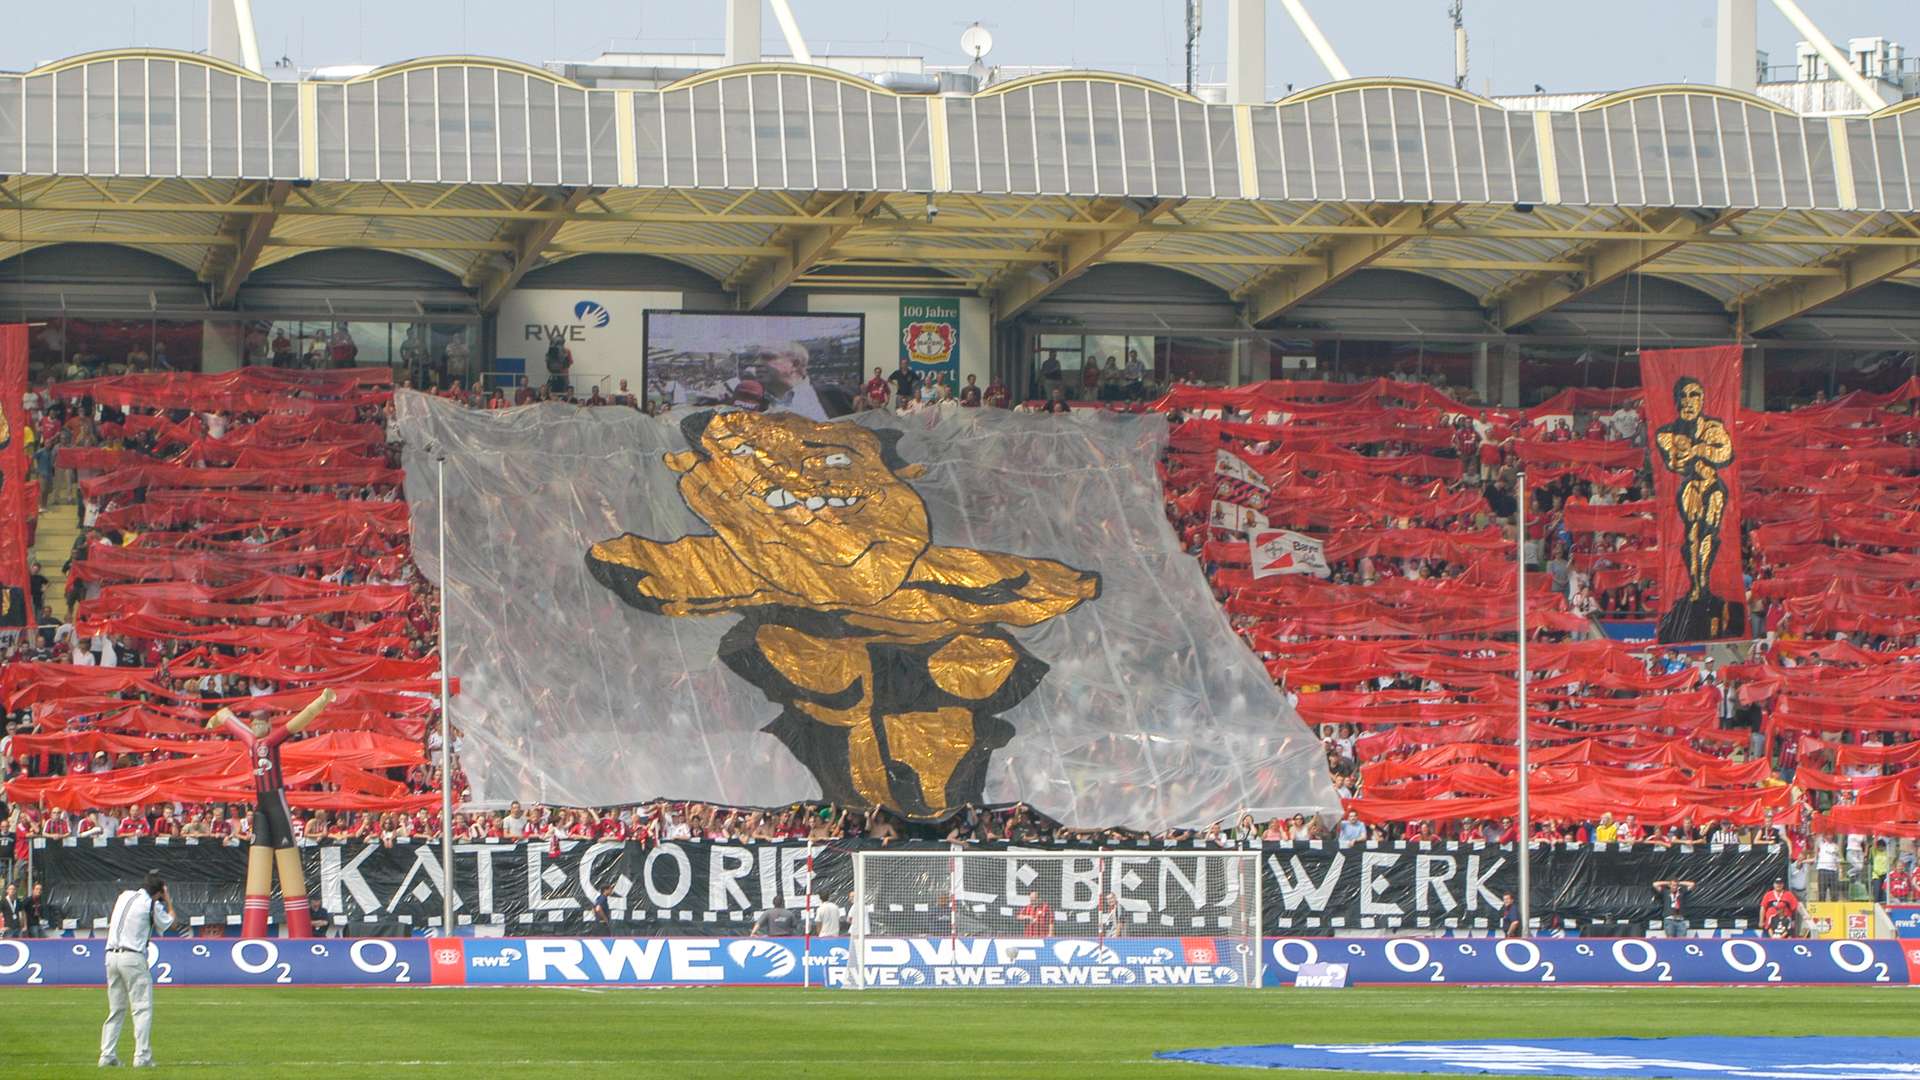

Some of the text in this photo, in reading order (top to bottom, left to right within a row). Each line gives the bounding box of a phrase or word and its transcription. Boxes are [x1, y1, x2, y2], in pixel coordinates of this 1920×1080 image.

[903, 306, 957, 318] 100 Jahre
[524, 324, 586, 341] RWE
[320, 841, 828, 914] KATEGORIE
[0, 940, 43, 983] O2
[231, 939, 293, 983] O2
[350, 939, 411, 983] O2
[471, 956, 510, 967] RWE
[526, 939, 724, 981] RWE
[802, 956, 840, 966] RWE
[1126, 956, 1163, 965] RWE
[1385, 939, 1445, 982] O2
[1495, 939, 1556, 982] O2
[1612, 939, 1673, 982] O2
[1721, 939, 1782, 982] O2
[1829, 939, 1890, 982] O2
[828, 966, 1214, 986] RWE RWE RWE RWE
